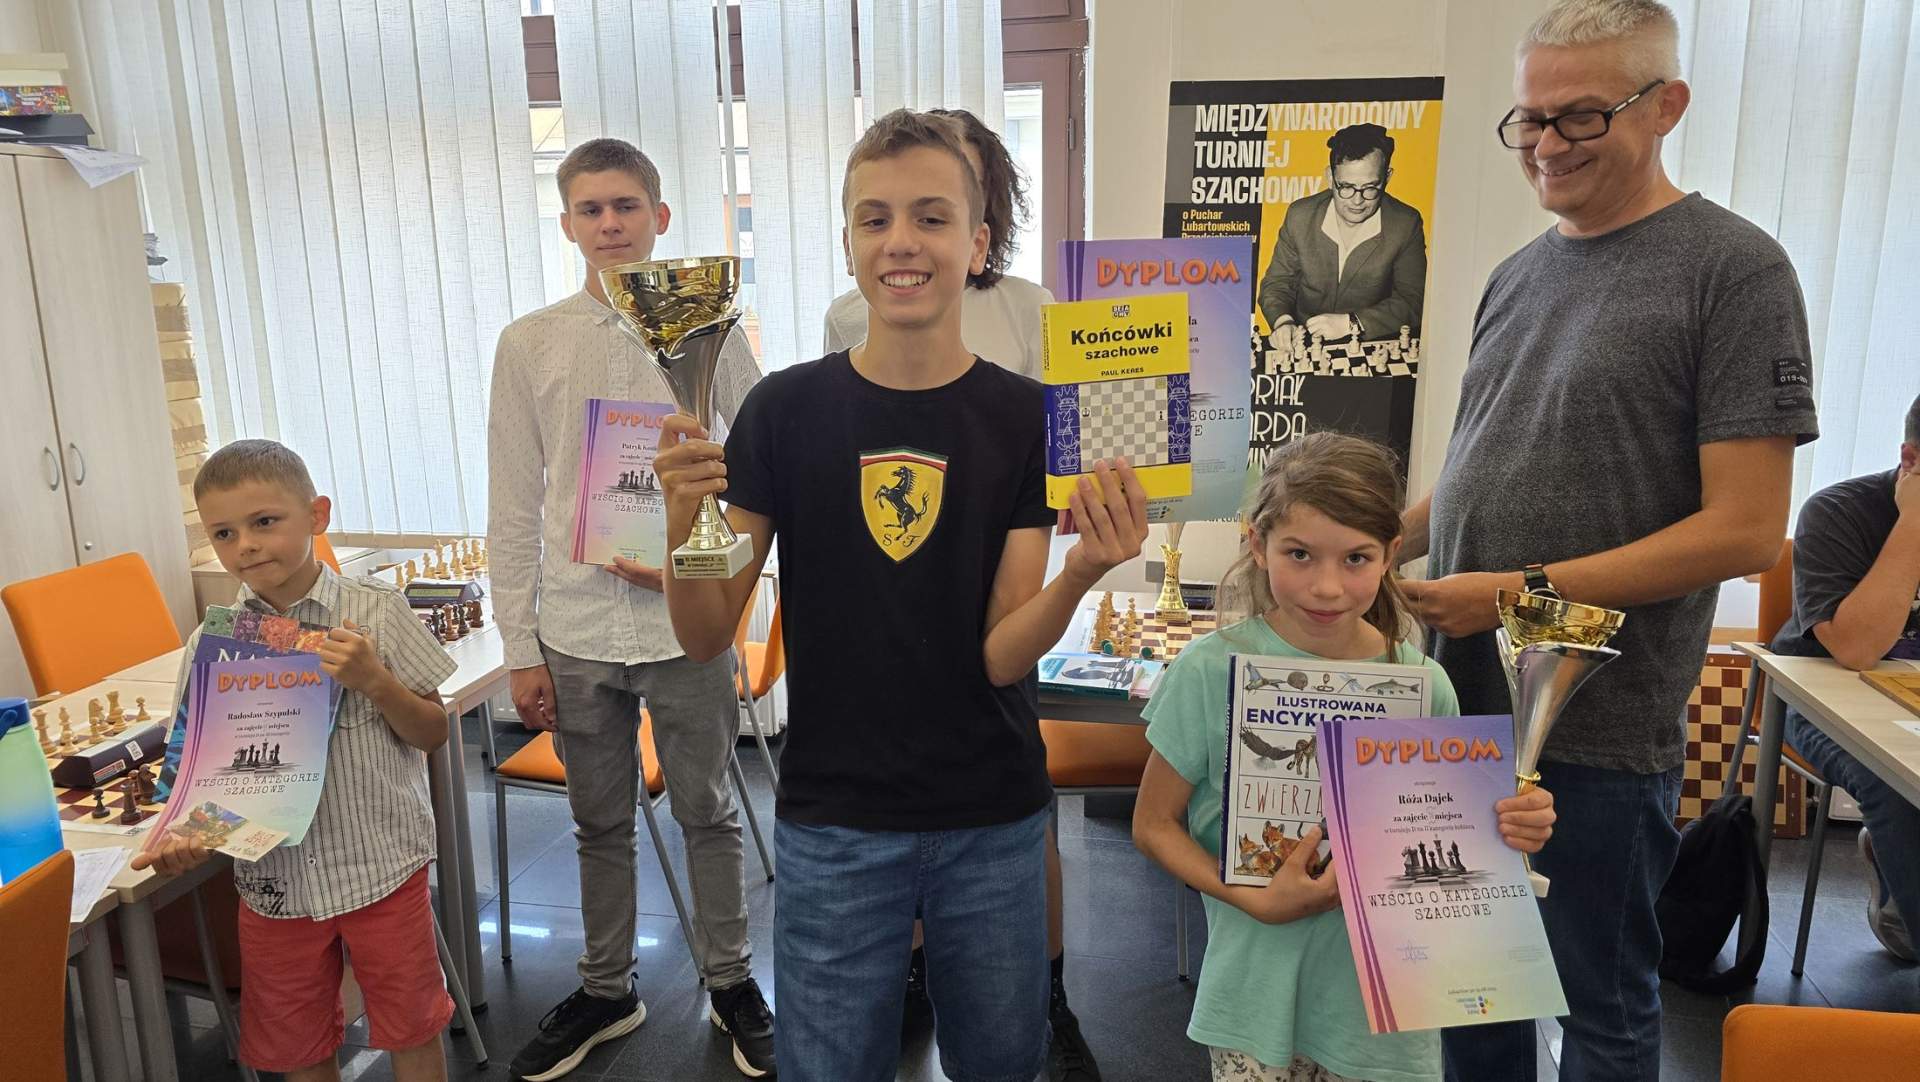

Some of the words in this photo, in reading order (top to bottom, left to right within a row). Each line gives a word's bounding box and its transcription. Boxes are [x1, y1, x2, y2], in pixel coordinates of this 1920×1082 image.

[1194, 100, 1427, 137] MIĘDZYNARODOWY
[1194, 139, 1291, 168] TURNIEJ
[1191, 175, 1322, 205] SZACHOWY
[1182, 211, 1188, 220] o
[1190, 209, 1223, 220] Puchar
[1182, 221, 1251, 232] Lubartowskich
[1097, 256, 1240, 288] DYPLOM
[1071, 321, 1173, 345] Końcówki
[1085, 344, 1159, 360] szachowe
[1101, 368, 1119, 377] PAUL
[1120, 367, 1144, 376] KERES
[1250, 374, 1306, 406] RIAŁ
[606, 410, 664, 429] DYPLO
[1190, 407, 1244, 421] EGORIE
[615, 504, 661, 515] SZACHOWE
[627, 496, 633, 504] O
[635, 496, 664, 506] KATEG
[217, 671, 322, 693] DYPLOM
[1277, 696, 1387, 714] ILUSTROWANA
[228, 711, 262, 721] Radosław
[264, 708, 301, 720] Szypulski
[1355, 736, 1503, 766] DYPLOM
[242, 777, 249, 786] O
[254, 773, 321, 785] KATEGORIE
[224, 785, 286, 796] SZACHOWE
[1398, 793, 1422, 804] Róża
[1424, 792, 1454, 805] Dajek
[1434, 812, 1463, 821] miejsca
[1368, 889, 1424, 908] WYŚCIG
[1429, 890, 1439, 904] O
[1442, 884, 1528, 902] KATEGORIE
[1415, 903, 1492, 921] SZACHOWE
